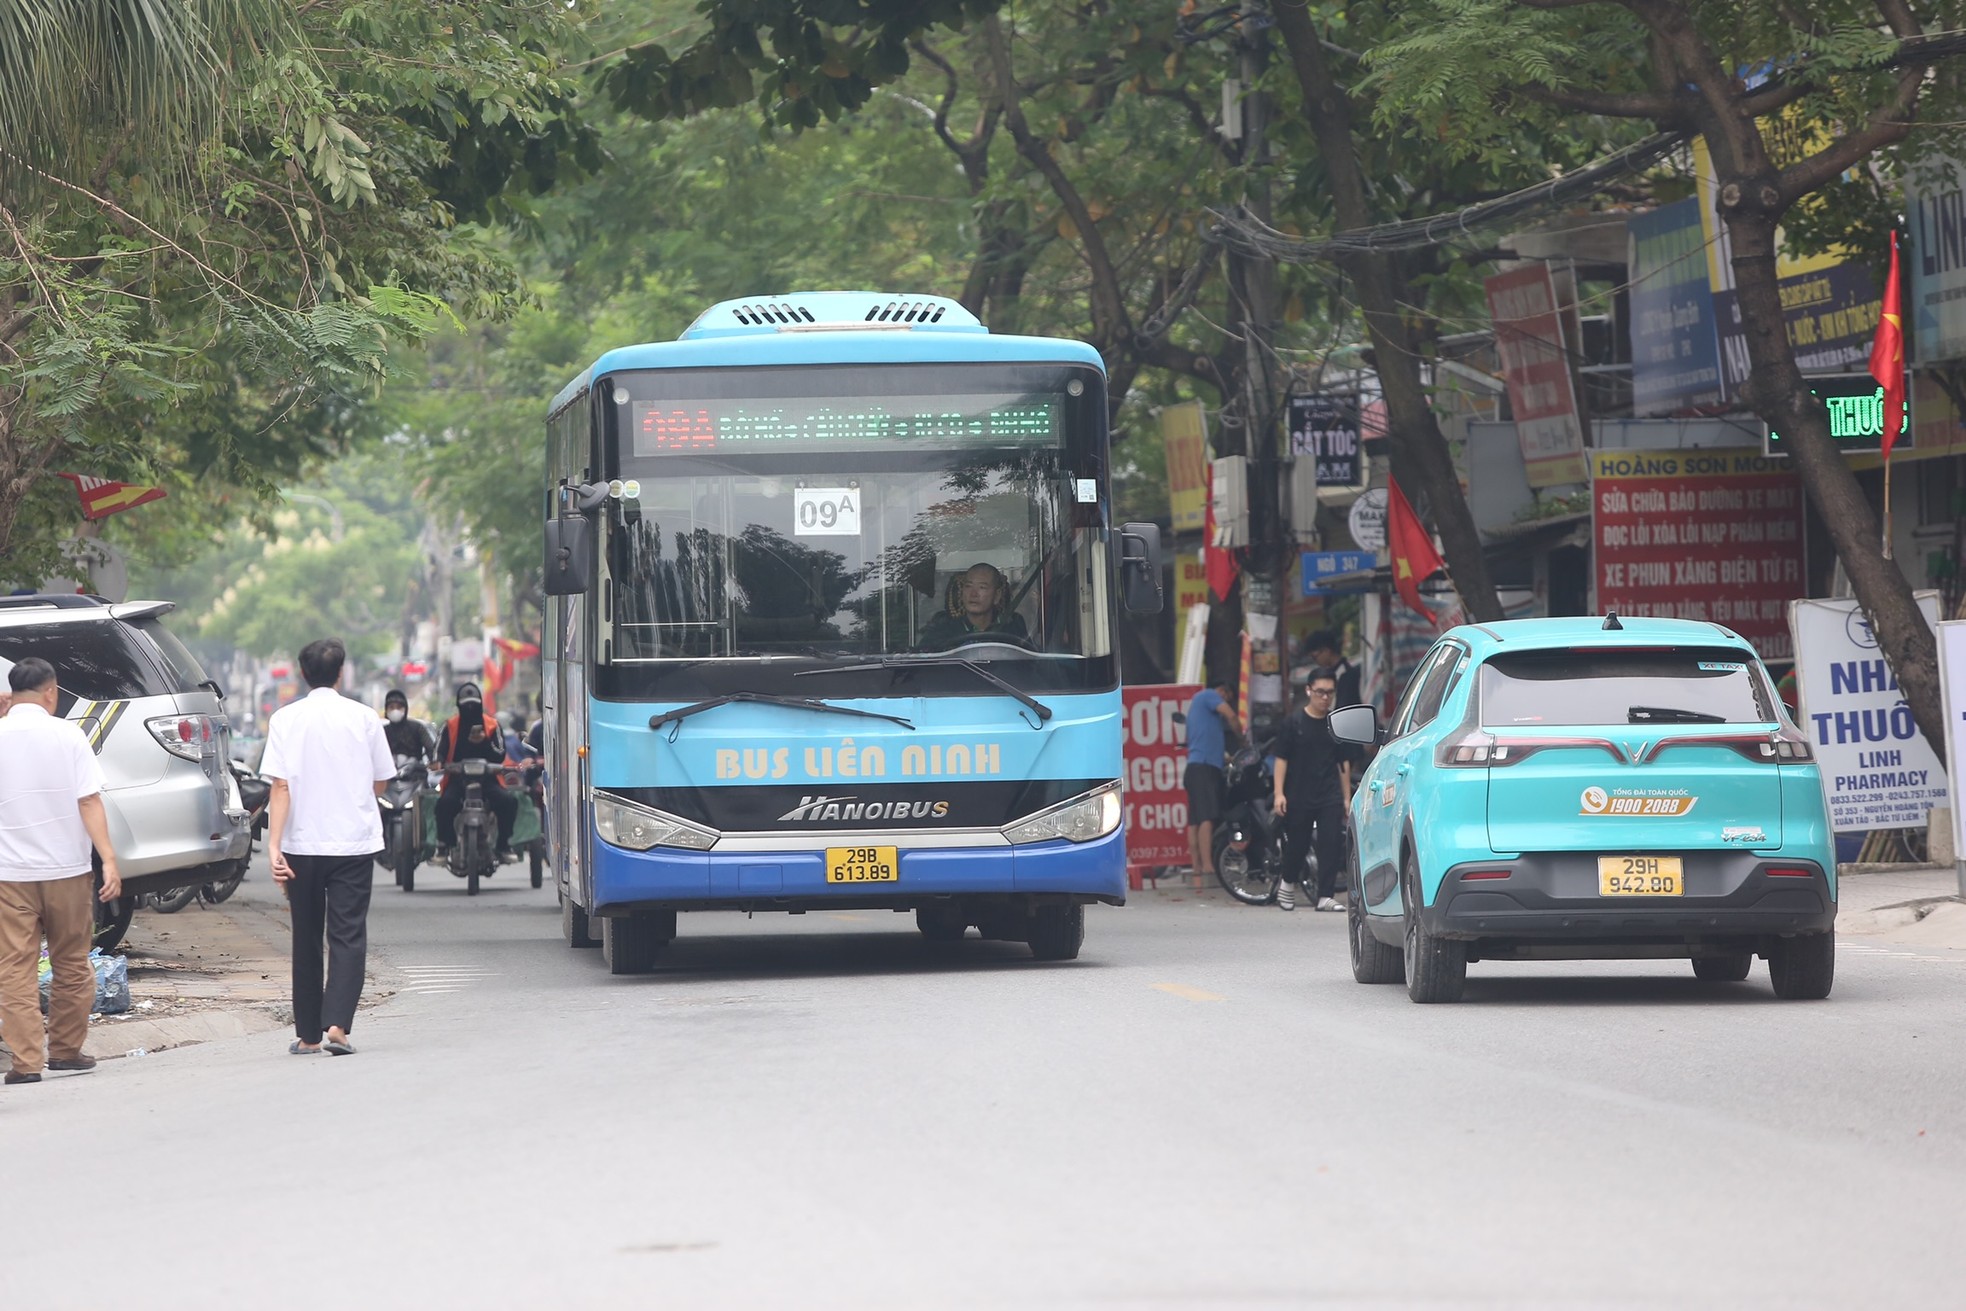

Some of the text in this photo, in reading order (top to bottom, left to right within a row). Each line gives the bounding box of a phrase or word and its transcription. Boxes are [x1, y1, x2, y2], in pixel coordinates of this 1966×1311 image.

[1292, 421, 1357, 456] CẮT TÓC
[1601, 455, 1678, 476] HOÀNG
[1685, 457, 1728, 474] SƠN
[1747, 490, 1762, 508] XE
[800, 495, 855, 528] 09A
[1604, 563, 1624, 588] XE
[1628, 562, 1671, 587] PHUN
[1675, 556, 1717, 585] XĂNG
[1721, 555, 1757, 588] ĐIỆN
[715, 738, 1001, 780] BUS LIÊN NINH
[1859, 750, 1902, 769] LINH
[1835, 770, 1928, 791] PHARMACY
[1613, 787, 1689, 797] TỔNG ĐÀI TOÀN QUỐC
[1610, 798, 1642, 813] 1900
[1845, 807, 1858, 815] 353
[846, 849, 878, 865] 29B
[833, 865, 891, 881] 613.89
[1623, 859, 1659, 874] 29H
[1610, 877, 1674, 893] 942.80
